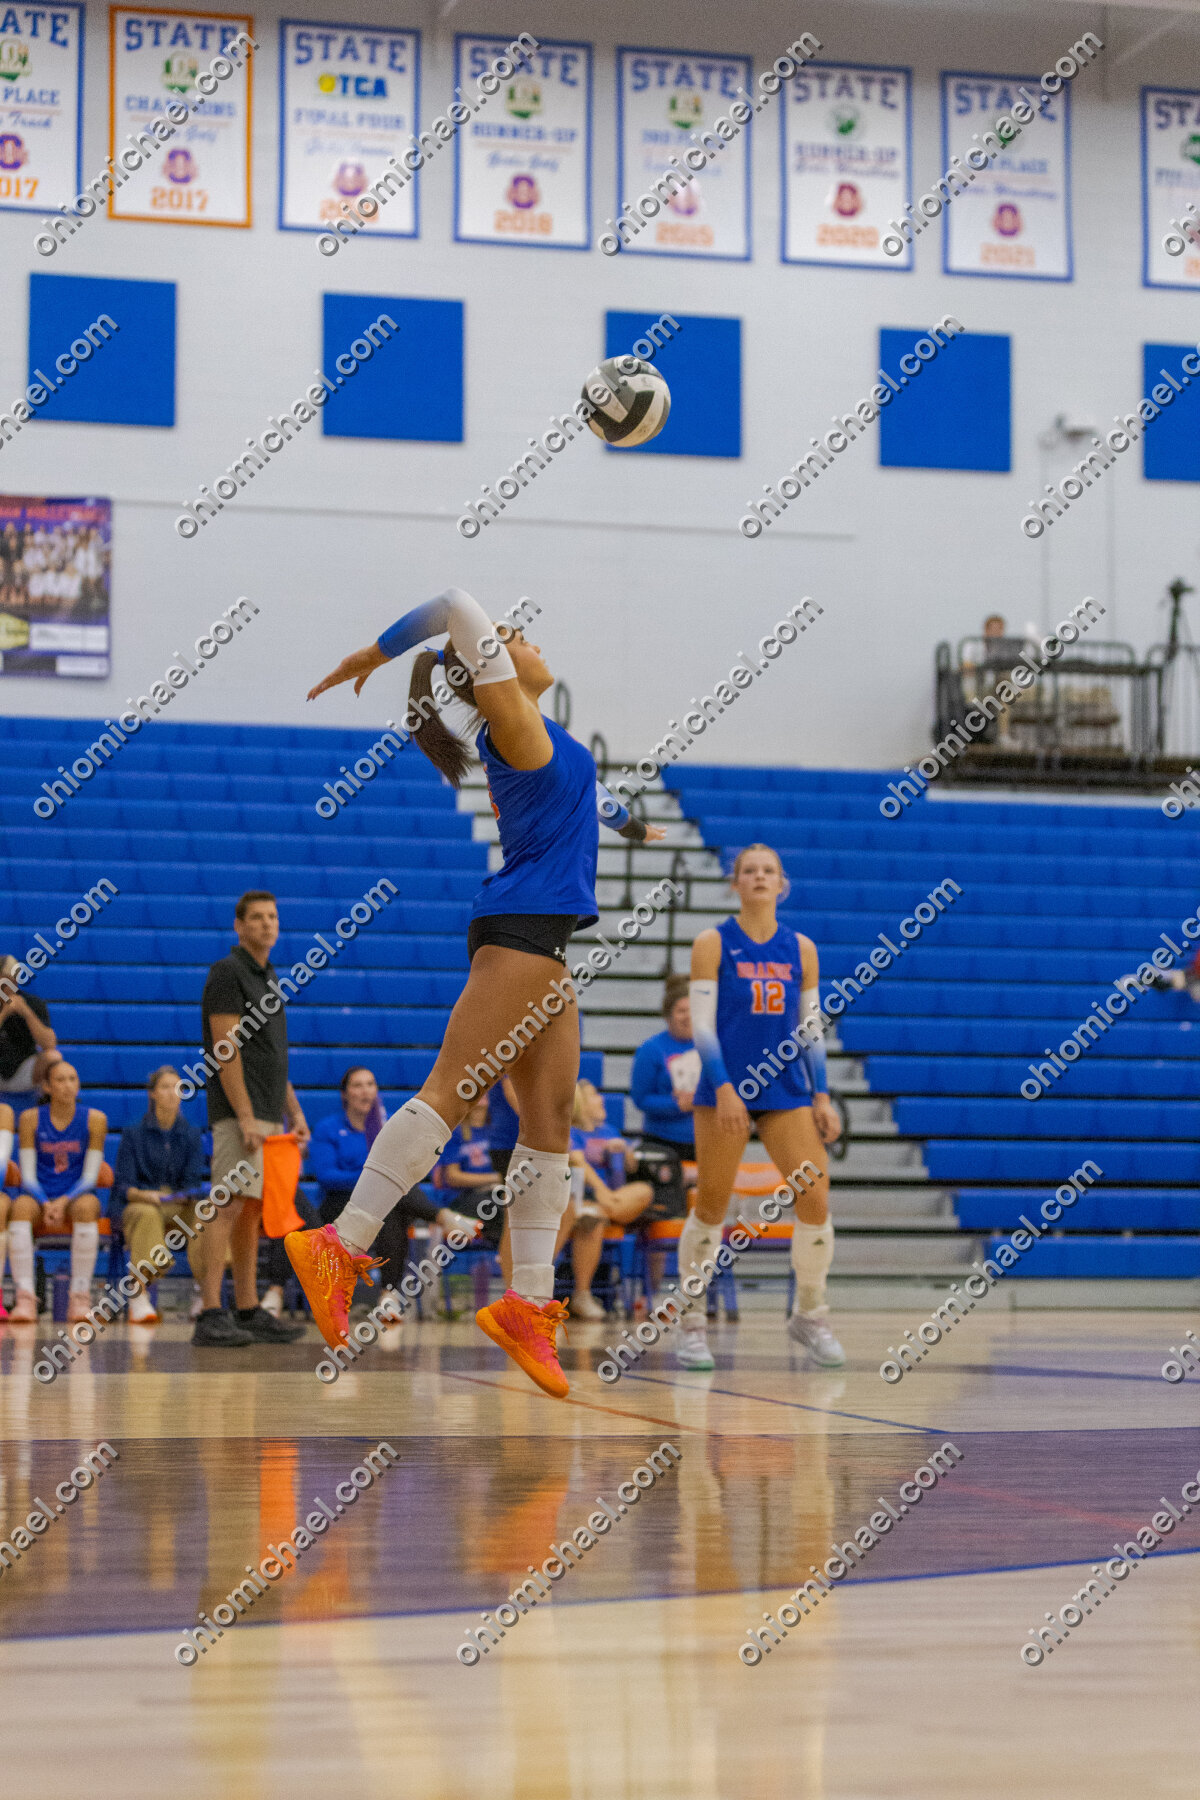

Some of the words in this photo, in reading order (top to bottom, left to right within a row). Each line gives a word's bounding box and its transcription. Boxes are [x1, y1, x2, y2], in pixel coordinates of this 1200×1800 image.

[0, 8, 70, 47] ATE
[294, 32, 407, 74] STATE
[4, 86, 61, 106] PLACE
[629, 57, 740, 99] STATE
[793, 70, 900, 111] STATE
[0, 176, 39, 199] 017
[151, 186, 209, 212] 2017
[751, 980, 785, 1015] 12
